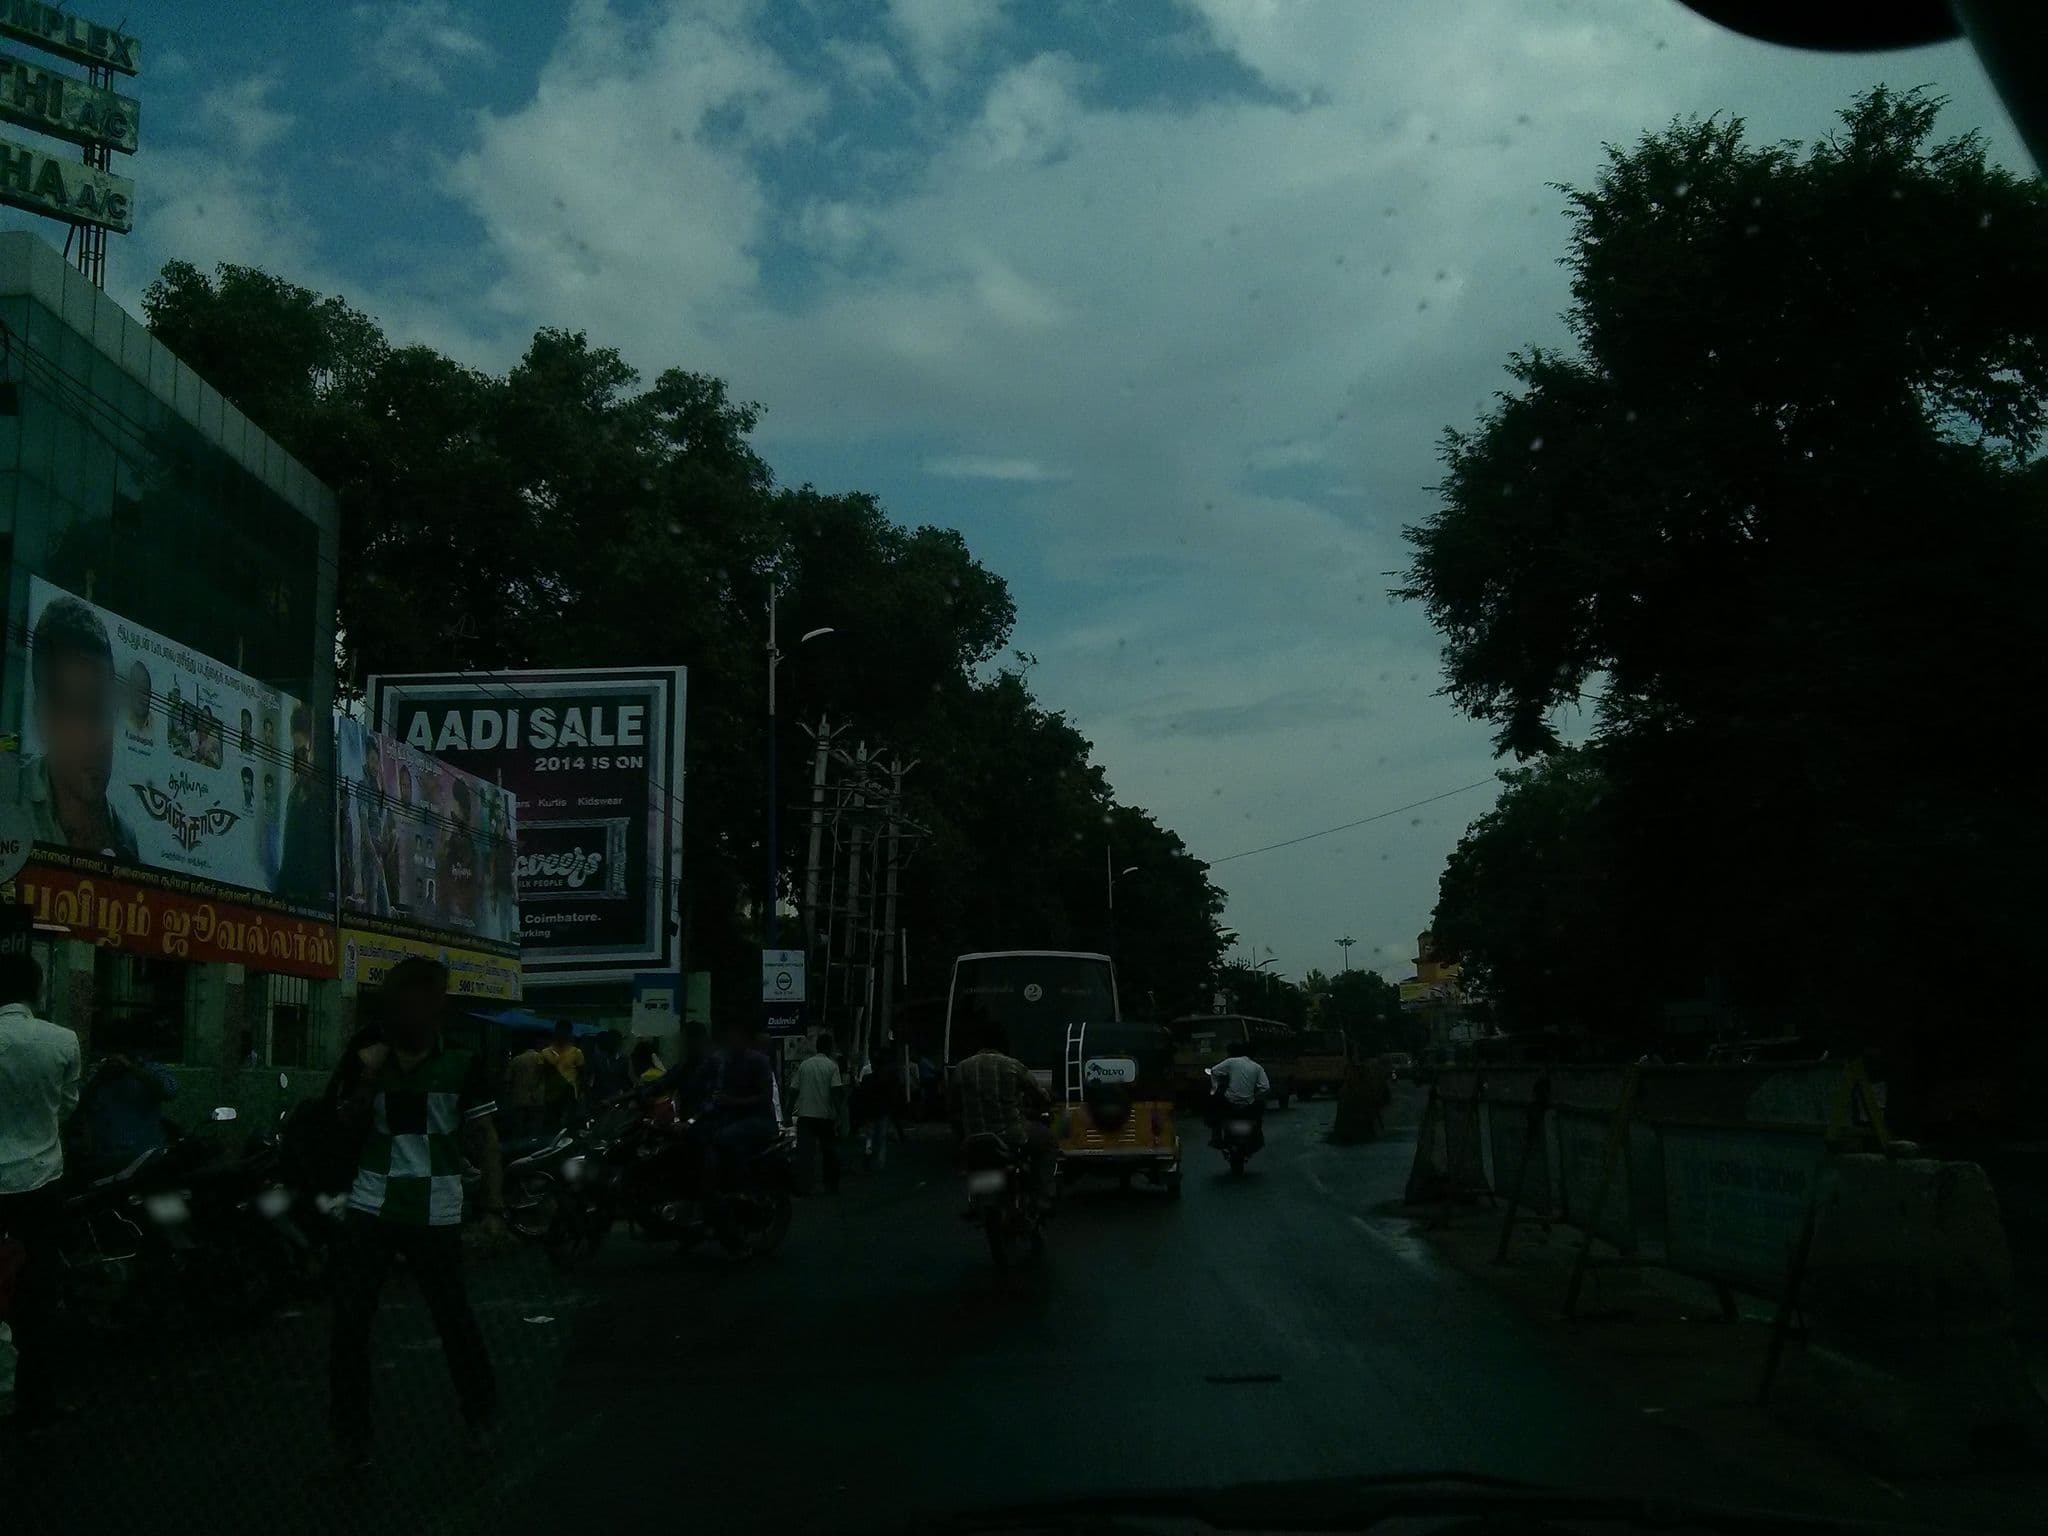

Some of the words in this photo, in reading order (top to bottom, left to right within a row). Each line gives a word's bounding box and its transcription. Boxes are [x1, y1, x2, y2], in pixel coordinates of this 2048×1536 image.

[0, 0, 140, 68] MPLEX
[0, 55, 63, 119] HI
[79, 102, 129, 138] A/C
[0, 145, 67, 203] HA
[78, 184, 128, 220] A/C
[406, 709, 519, 751] AADI
[529, 705, 645, 750] SALE
[535, 756, 586, 772] 2014
[592, 756, 611, 770] IS
[615, 755, 644, 770] ON
[538, 797, 568, 808] Kurtis
[577, 796, 623, 807] Kidswear
[0, 839, 20, 855] NG
[533, 878, 564, 887] PEOPLE
[0, 930, 27, 953] eld
[519, 929, 551, 939] arking
[1096, 1066, 1125, 1077] VOLVO
